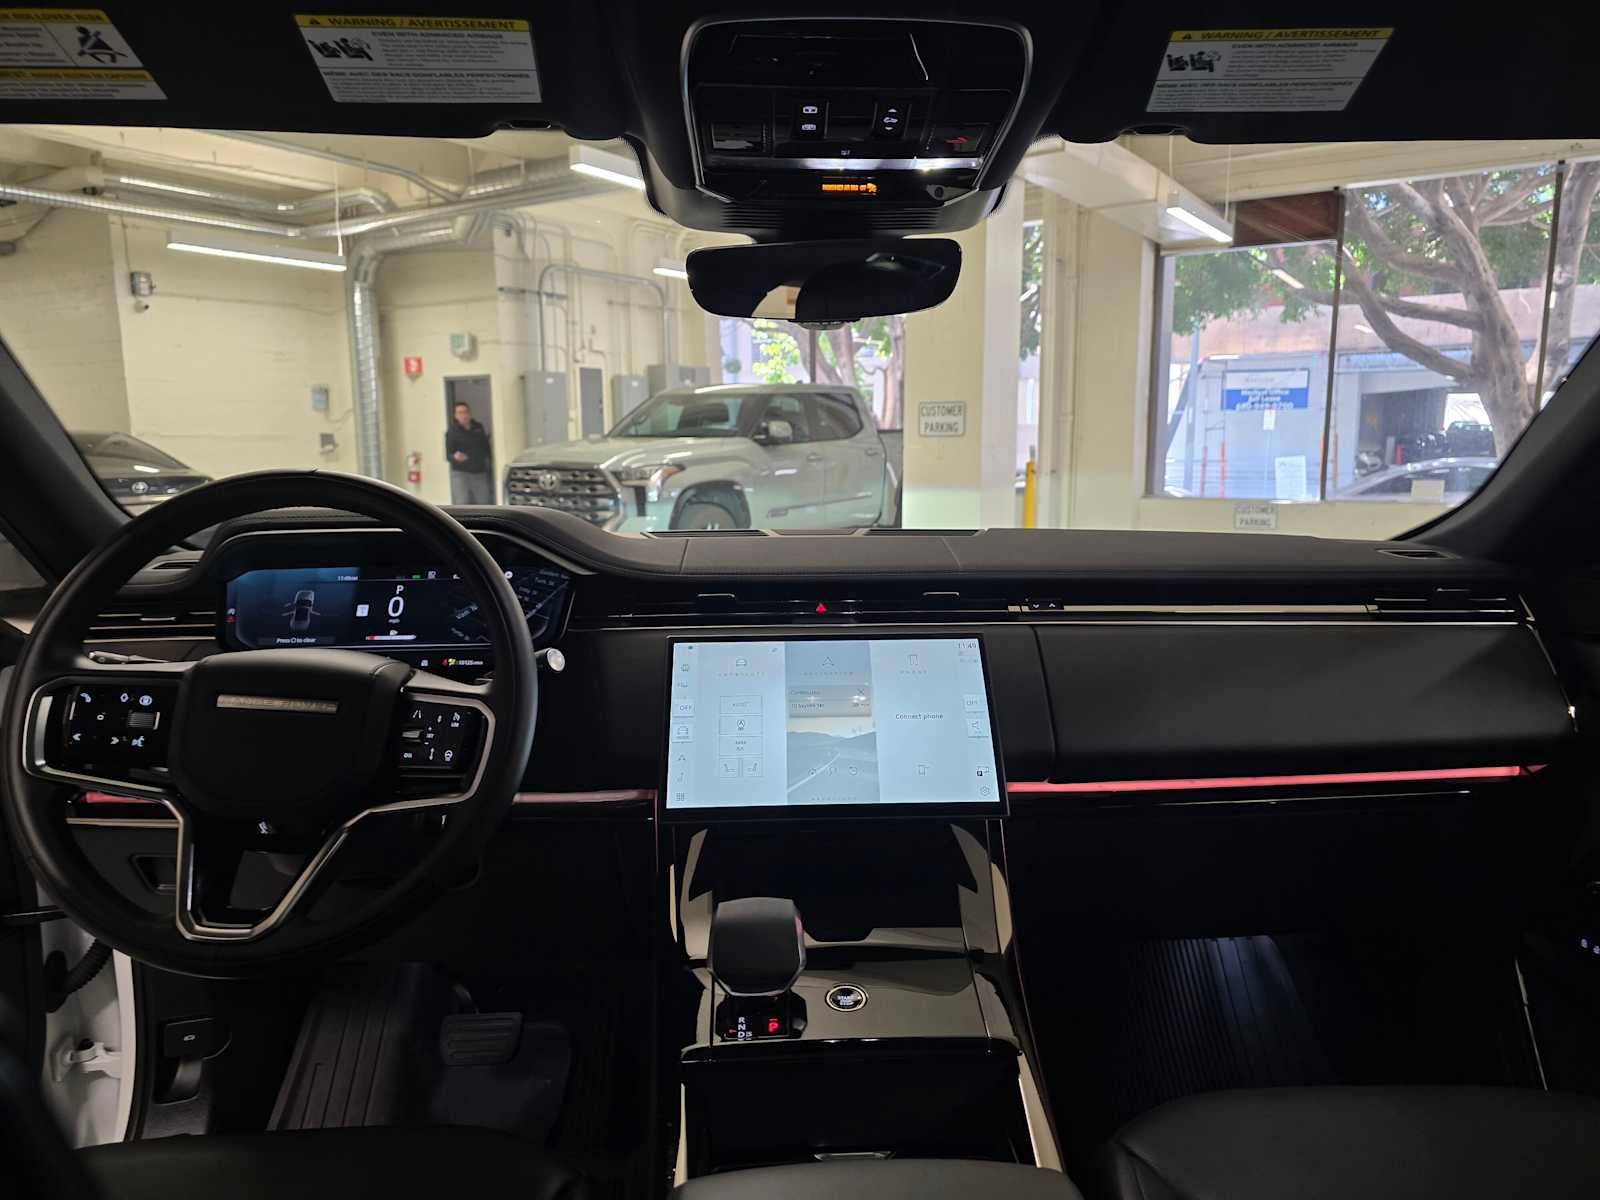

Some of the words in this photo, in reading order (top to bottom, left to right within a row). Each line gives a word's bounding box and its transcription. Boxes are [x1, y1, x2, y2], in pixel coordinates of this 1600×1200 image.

[328, 18, 395, 26] WARNING
[408, 18, 516, 29] AVERTISSEMENT
[1200, 31, 1264, 40] WARNING
[1273, 29, 1381, 39] AVERTISSEMENT
[921, 405, 962, 417] CUSTOMER
[924, 421, 959, 433] PARKING
[1239, 518, 1273, 527] PARKING
[396, 584, 405, 594] P
[388, 596, 404, 617] 0
[679, 703, 693, 711] OFF
[896, 712, 922, 721] Connect
[923, 712, 944, 722] phone
[738, 1016, 746, 1024] R
[767, 1021, 780, 1033] P
